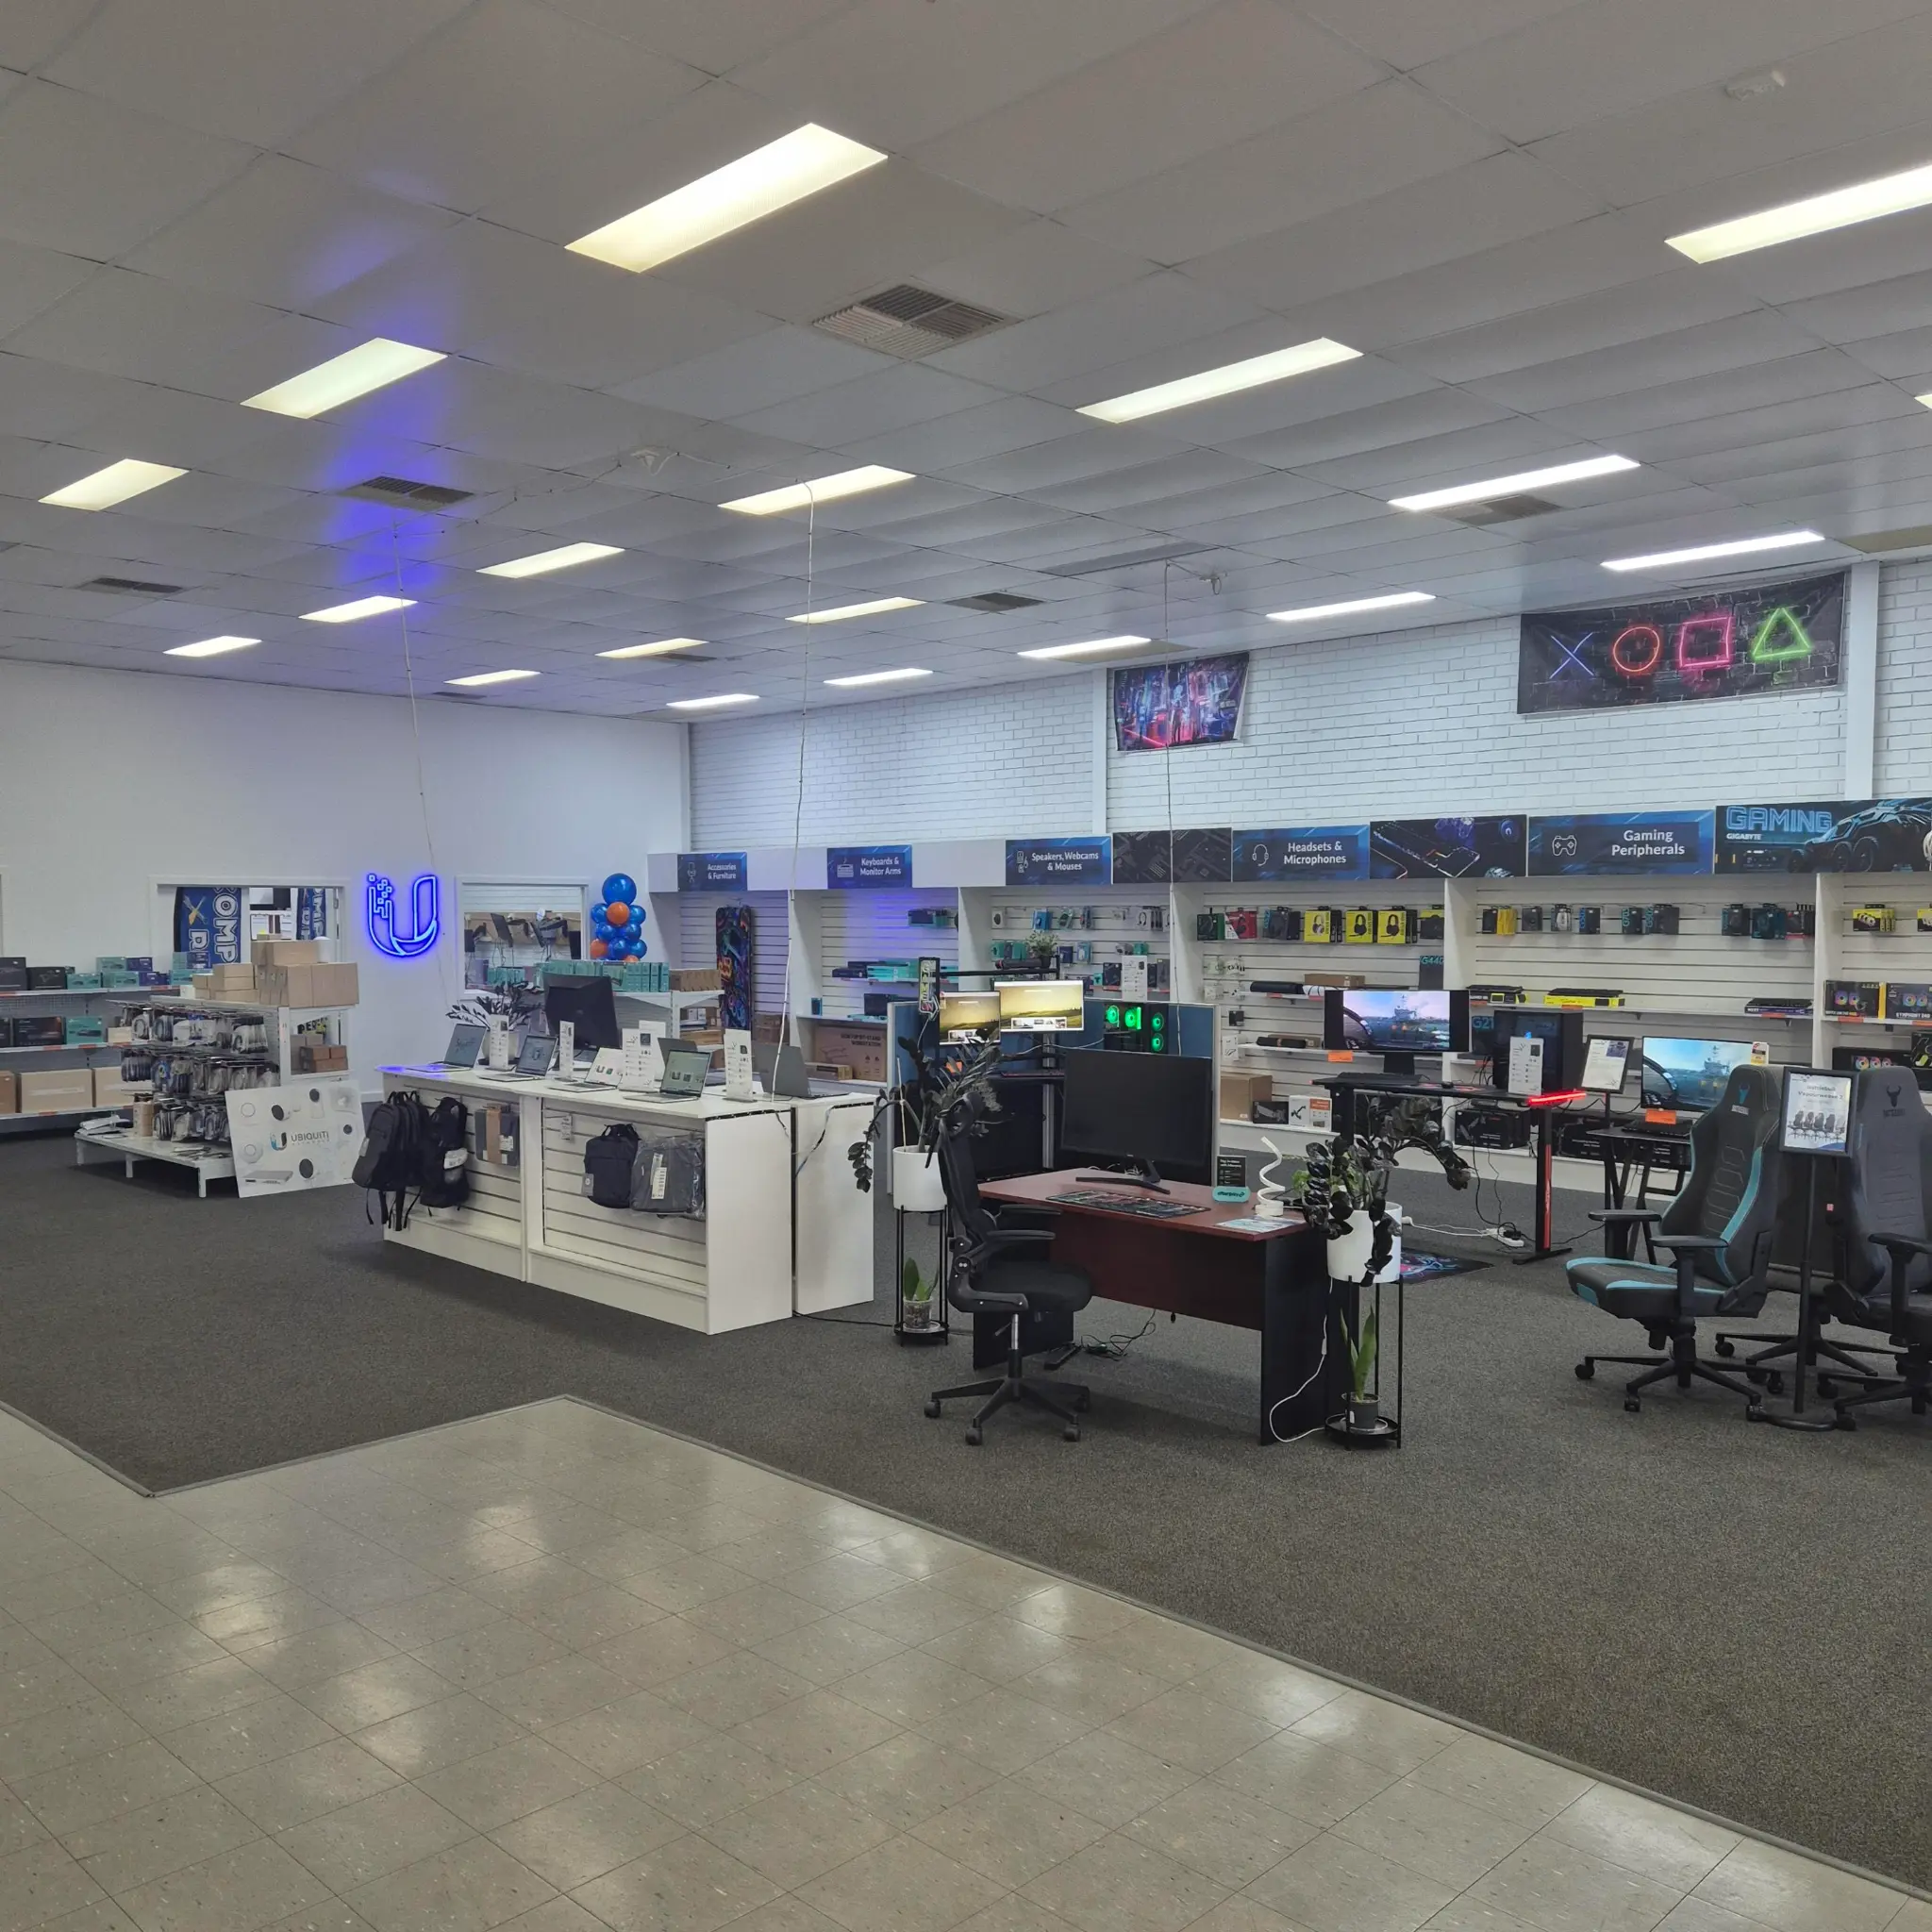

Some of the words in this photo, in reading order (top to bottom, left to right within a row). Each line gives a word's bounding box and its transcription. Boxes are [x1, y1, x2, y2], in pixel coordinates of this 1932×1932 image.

[1725, 806, 1832, 833] GAMING
[1623, 828, 1674, 842] Gaming
[1288, 841, 1332, 852] Headsets
[1334, 841, 1342, 851] &
[1611, 843, 1685, 858] Peripherals
[861, 857, 892, 866] Keyboards
[893, 857, 900, 865] &
[1031, 852, 1064, 861] Speakers,
[1064, 852, 1099, 860] Webcams
[1283, 854, 1347, 866] Microphones
[708, 863, 737, 872] Accessories
[859, 866, 884, 875] Monitor
[885, 866, 901, 875] Arms
[1047, 862, 1054, 871] &
[1055, 862, 1082, 871] Mouses
[713, 872, 737, 880] Furniture
[291, 1130, 329, 1142] UBIQUITI
